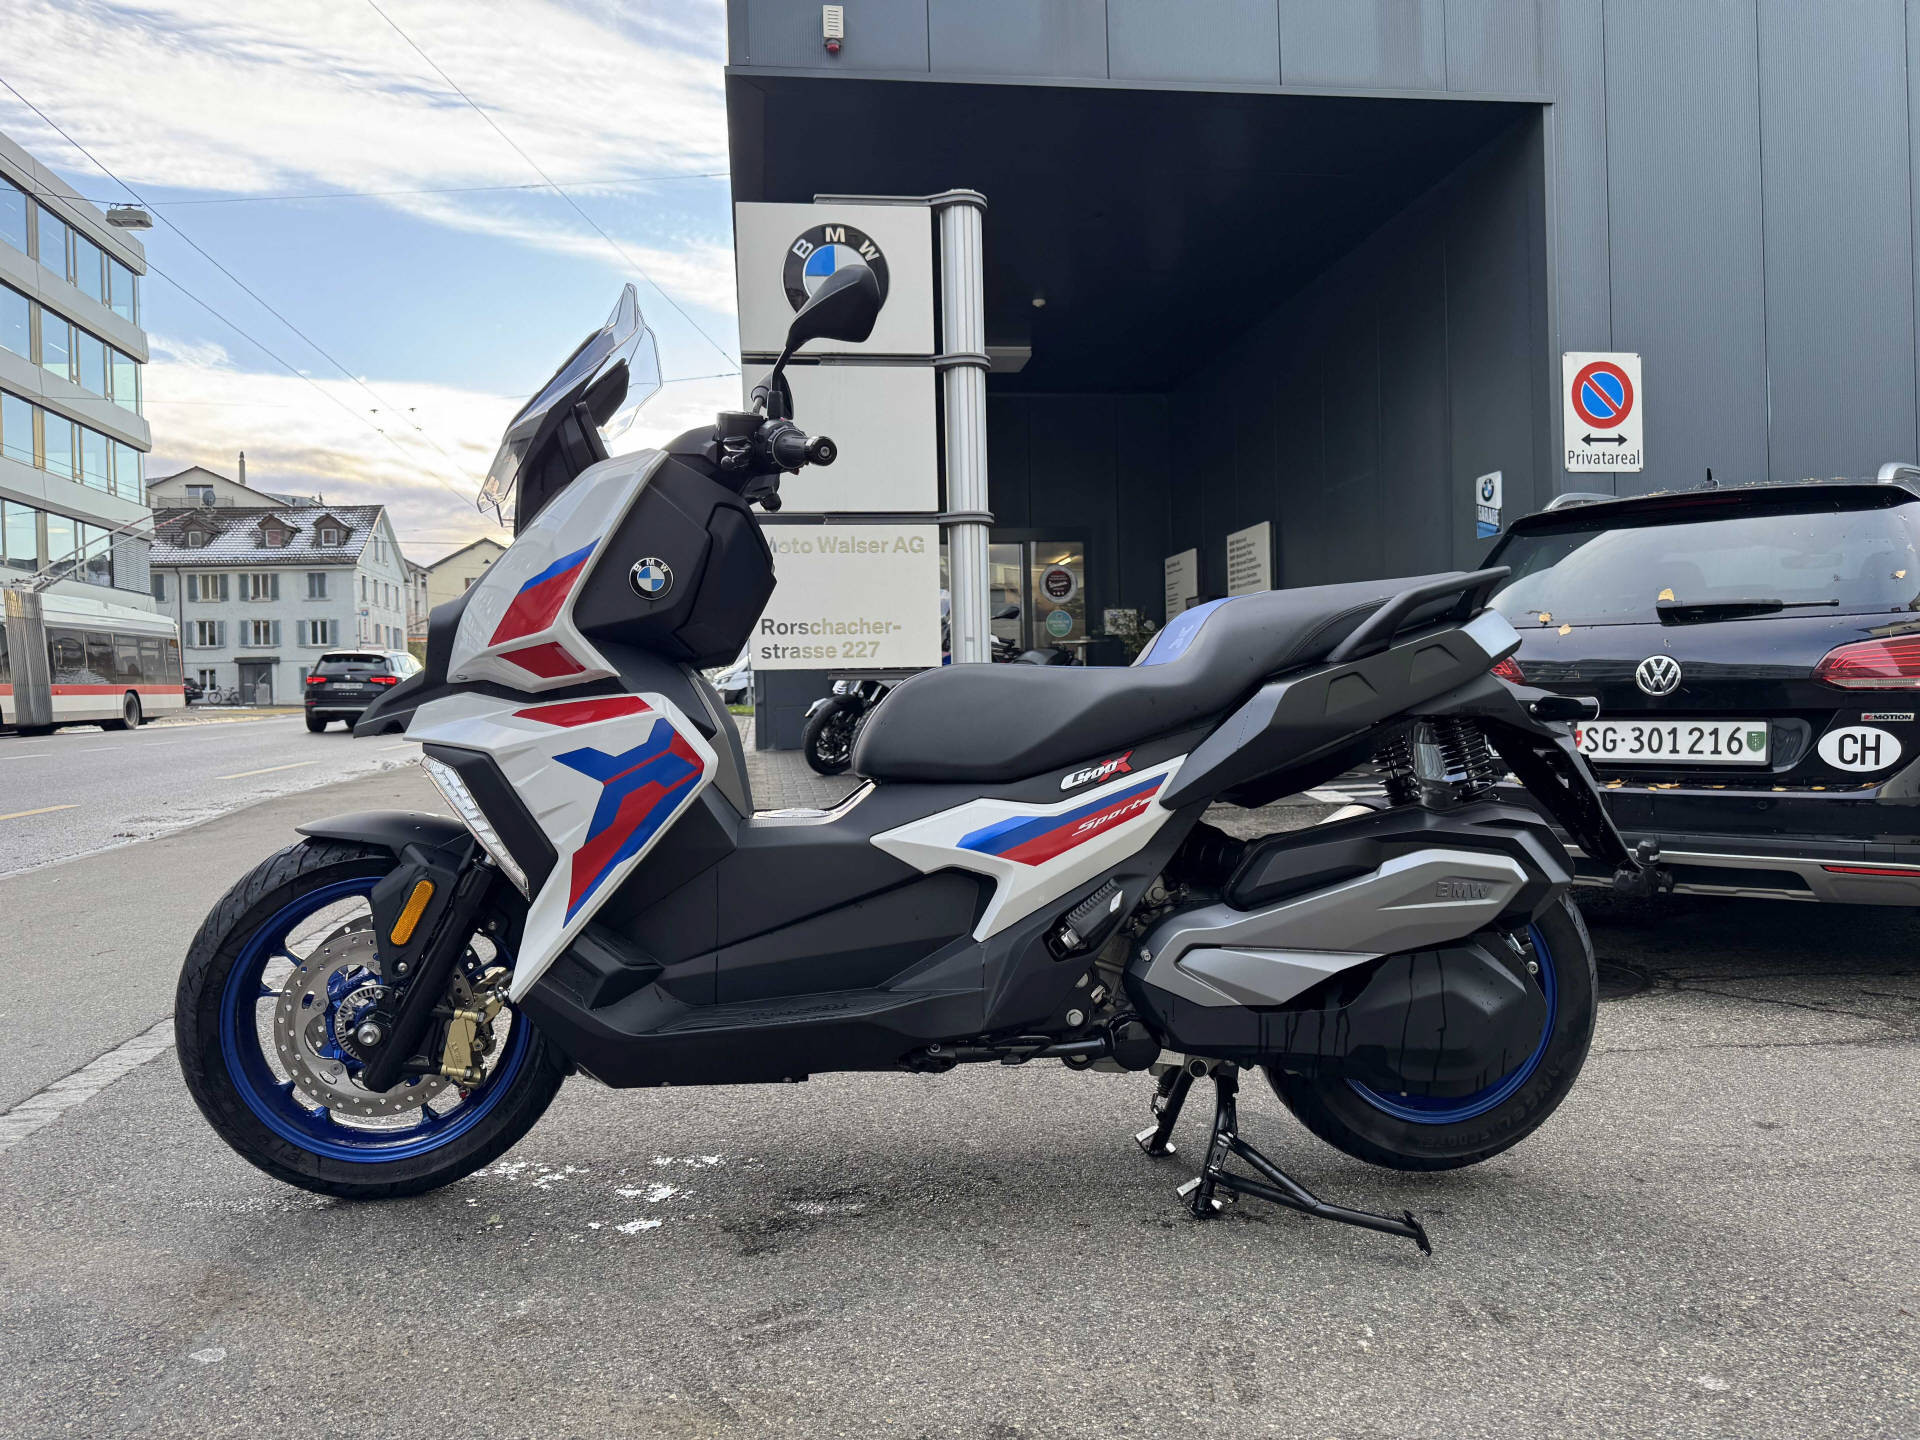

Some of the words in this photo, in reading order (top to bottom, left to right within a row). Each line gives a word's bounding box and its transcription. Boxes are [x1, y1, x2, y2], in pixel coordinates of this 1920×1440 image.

[791, 226, 880, 262] BMW
[1568, 449, 1640, 465] Privatareal
[817, 535, 888, 554] Walser
[893, 536, 925, 554] AG
[761, 618, 902, 635] Rorschacher-
[761, 643, 838, 660] strasse
[842, 641, 881, 658] 227
[1837, 733, 1881, 766] CH
[1060, 750, 1134, 790] C400X
[1435, 881, 1489, 899] BMW
